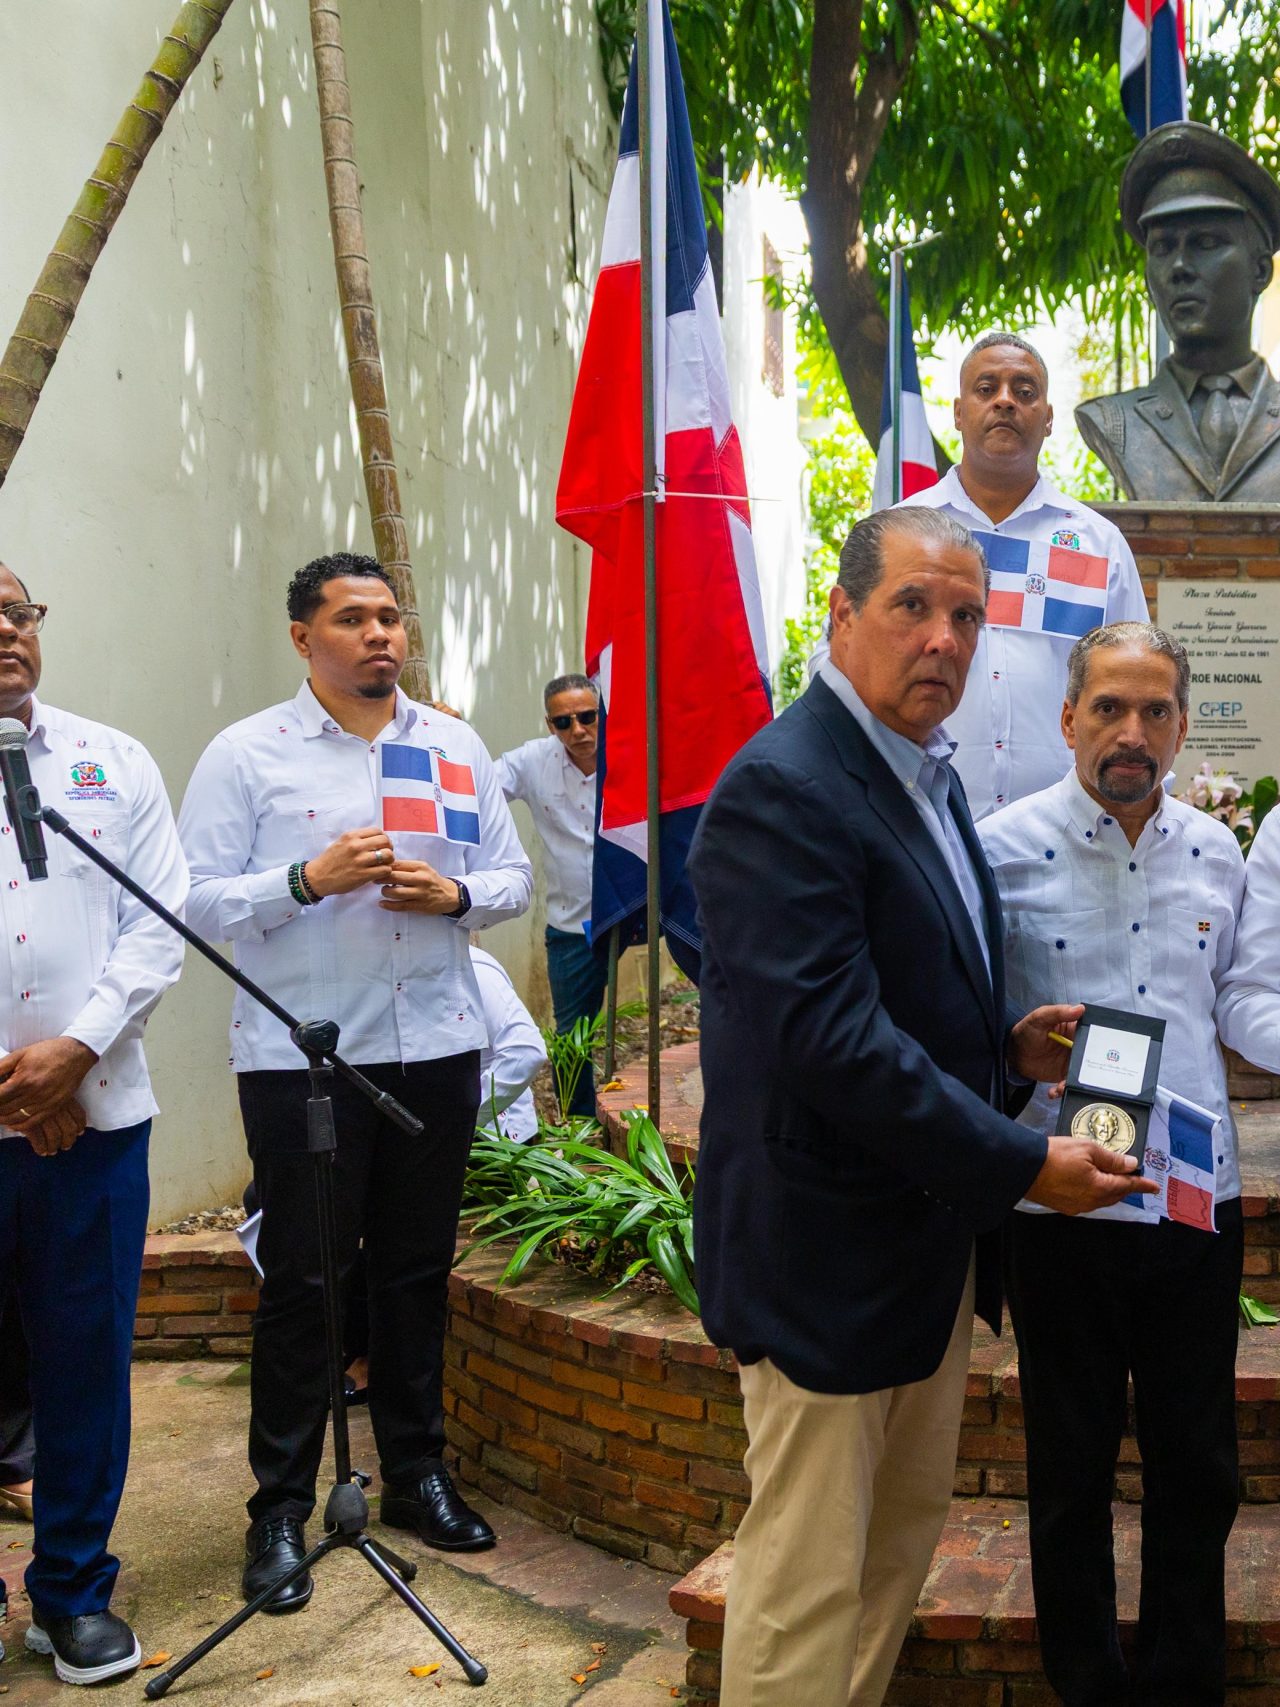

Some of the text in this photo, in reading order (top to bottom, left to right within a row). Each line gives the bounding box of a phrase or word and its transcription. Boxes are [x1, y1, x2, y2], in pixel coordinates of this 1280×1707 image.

[1182, 587, 1210, 599] Plaza
[1204, 607, 1236, 617] Teniente
[1191, 635, 1228, 645] Nacional
[1190, 673, 1263, 683] ROE NACIONAL
[1199, 702, 1243, 717] CPEP
